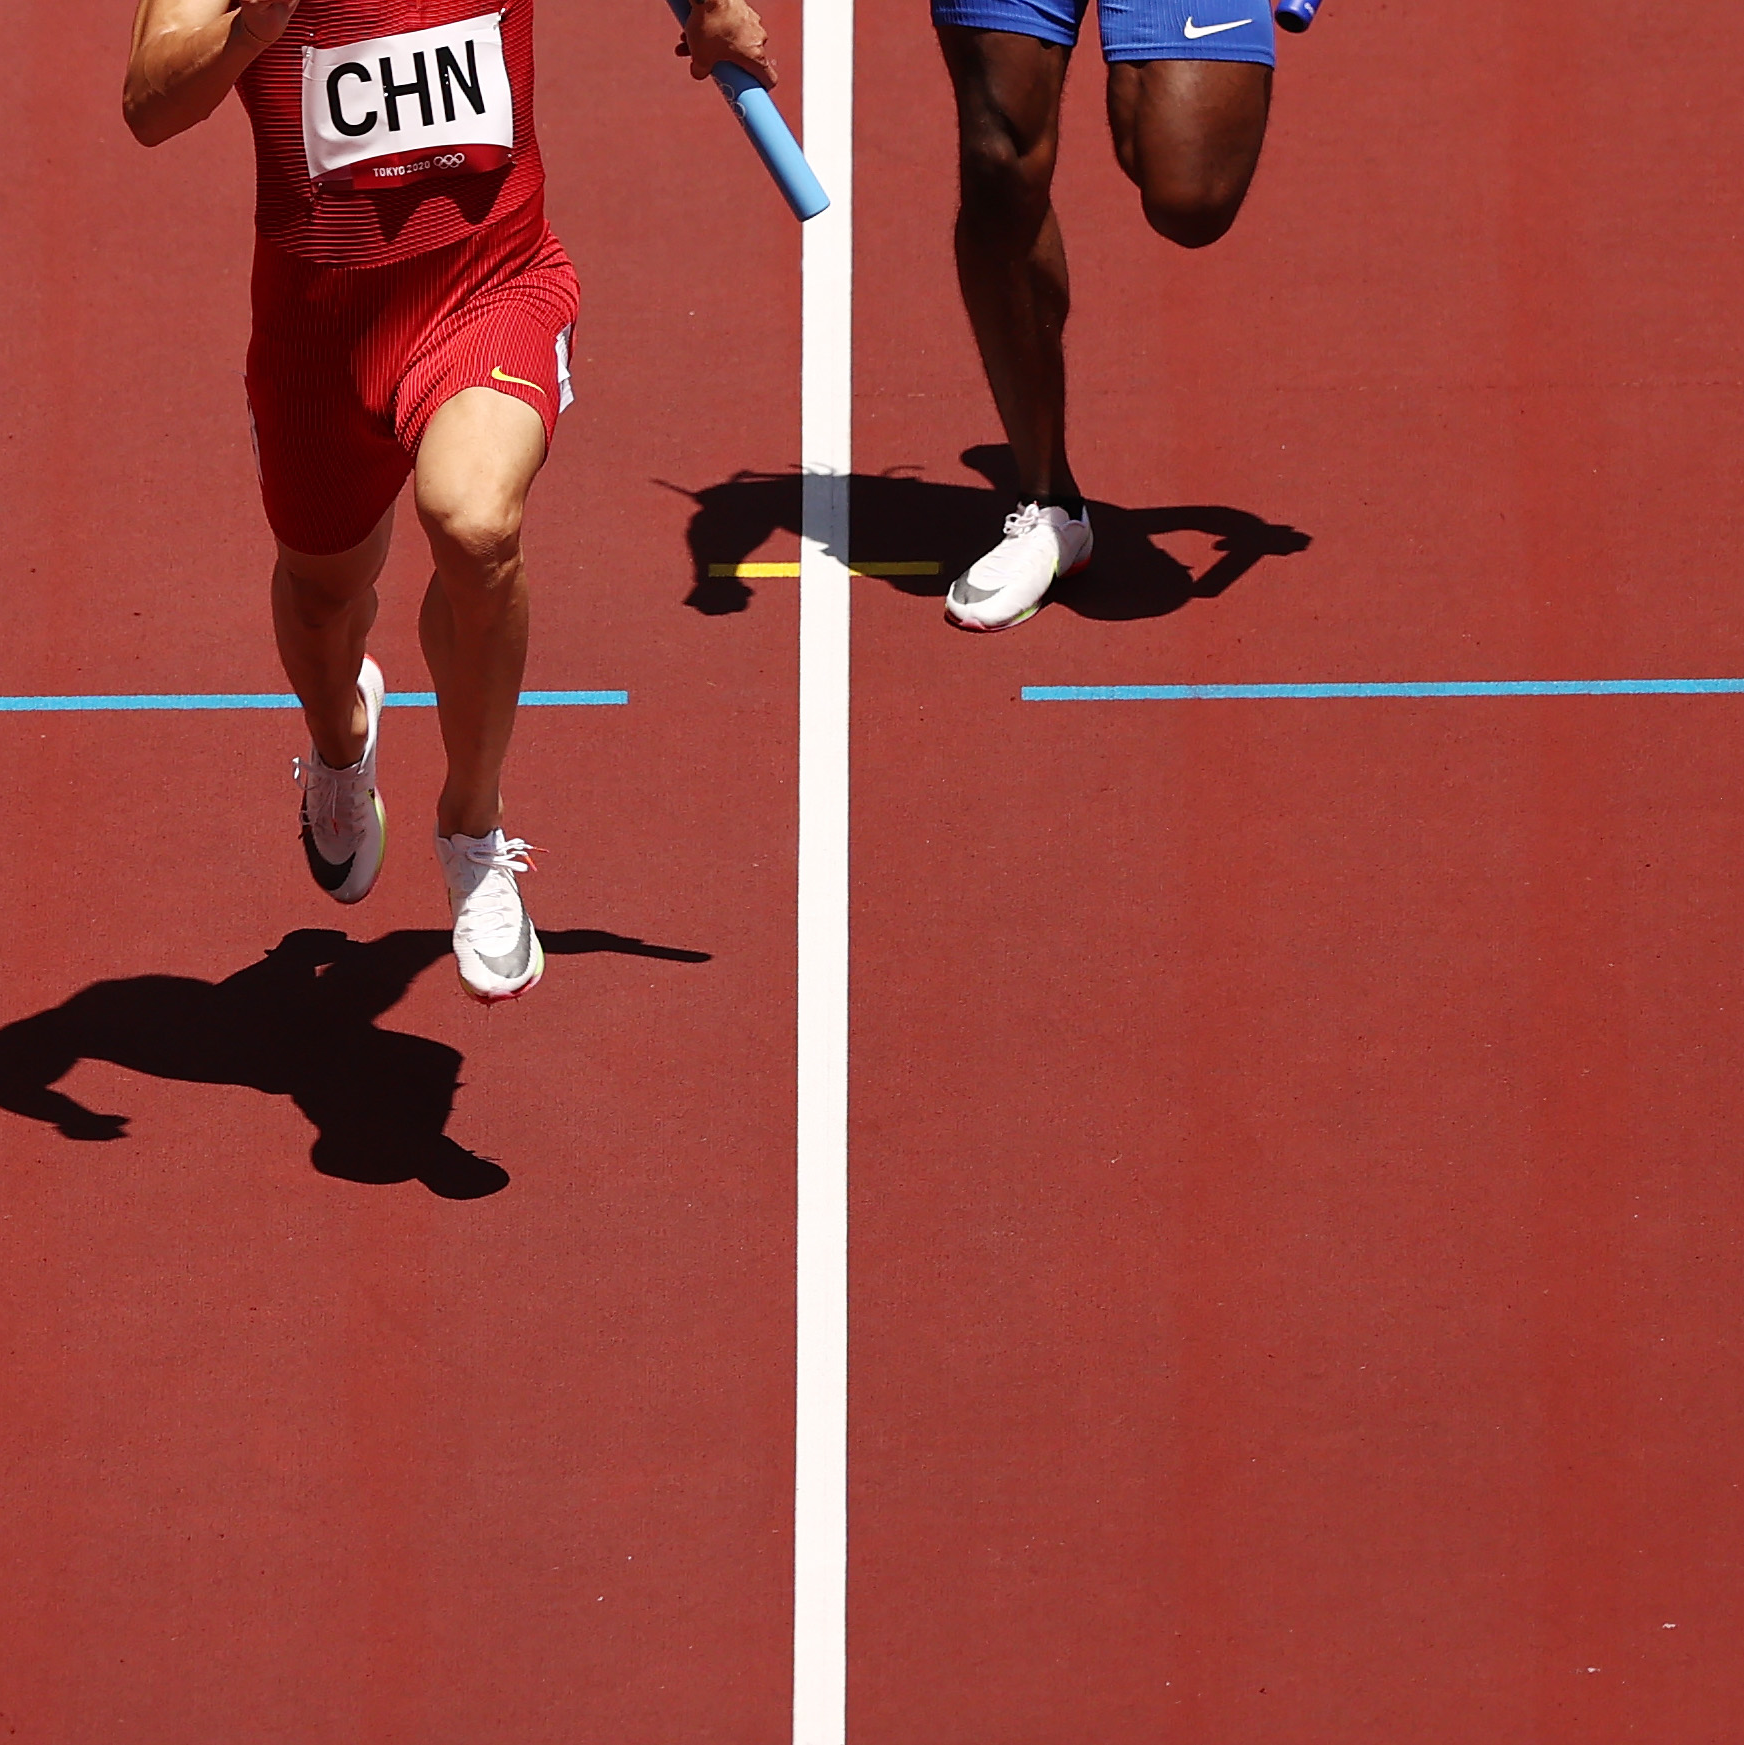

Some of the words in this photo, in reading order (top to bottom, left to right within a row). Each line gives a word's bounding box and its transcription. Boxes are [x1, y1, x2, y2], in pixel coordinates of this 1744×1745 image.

[325, 39, 486, 137] CHN
[372, 166, 405, 177] TOKYO
[406, 160, 431, 173] 2020
